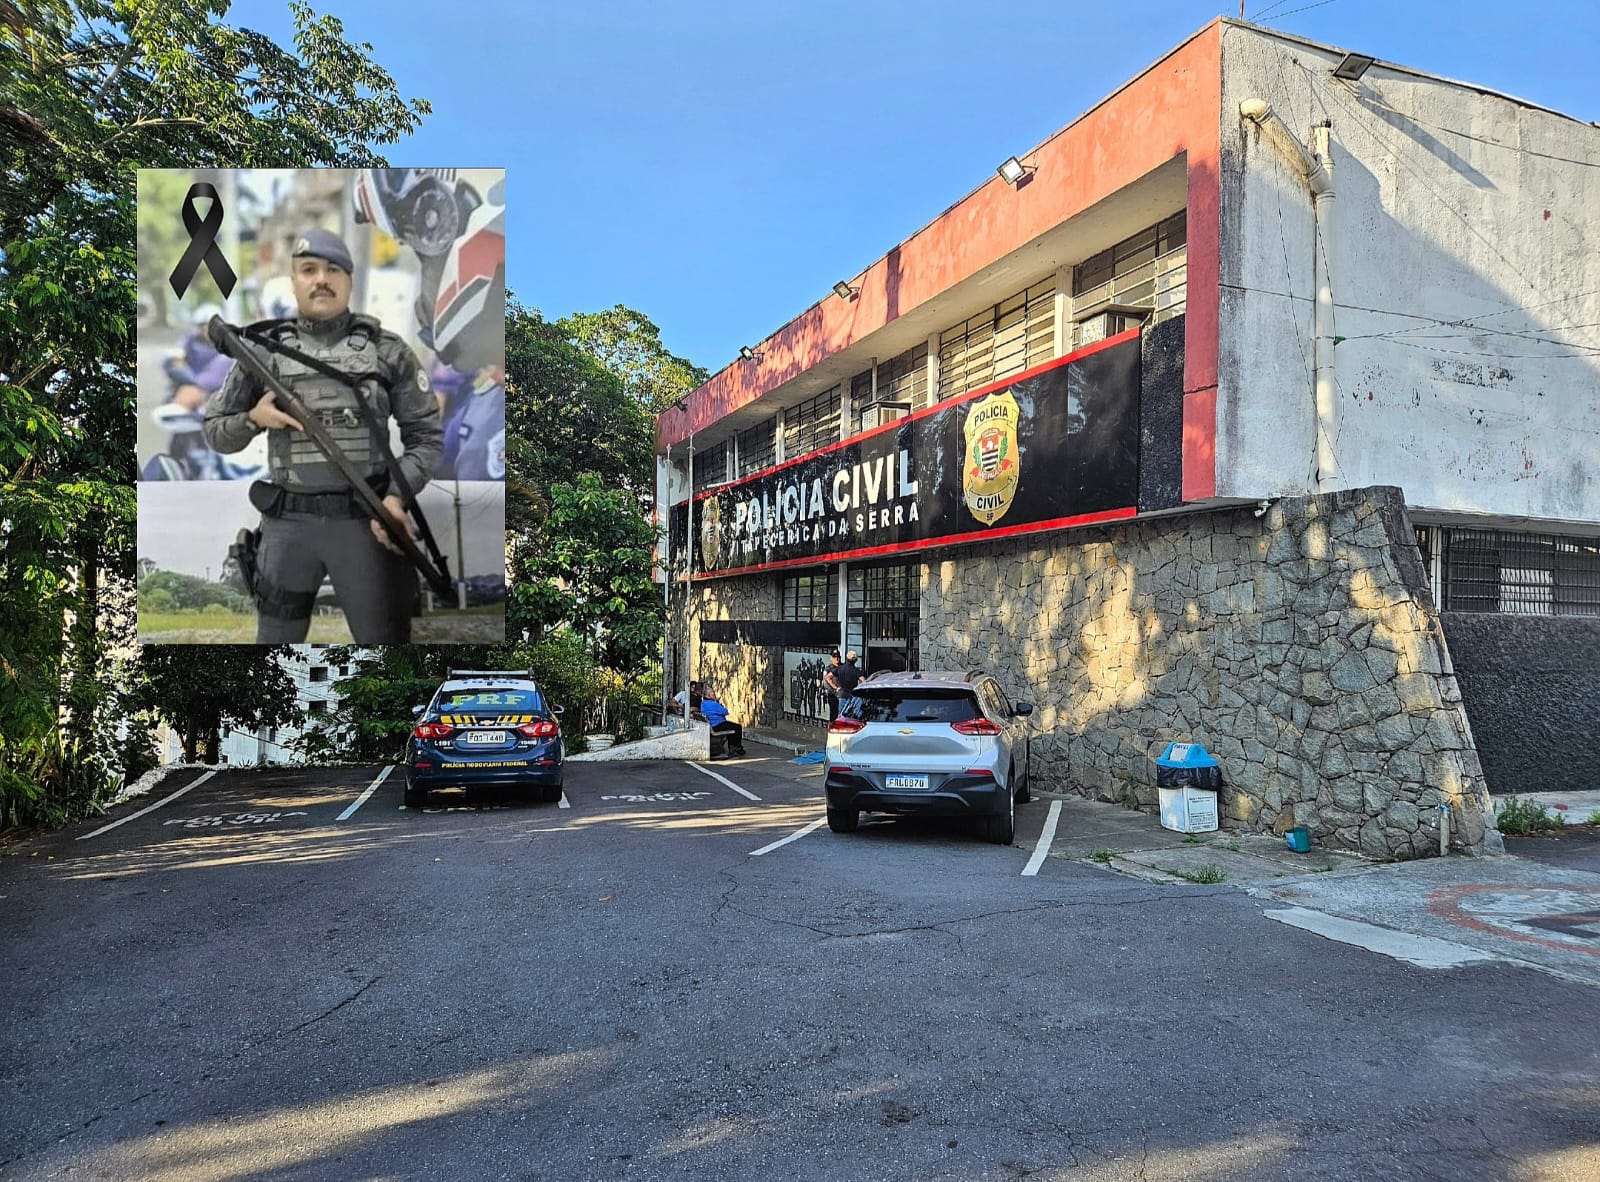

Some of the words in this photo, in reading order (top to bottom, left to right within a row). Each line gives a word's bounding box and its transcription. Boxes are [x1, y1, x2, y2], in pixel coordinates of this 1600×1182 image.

[833, 449, 919, 513] CIVIL
[976, 494, 1004, 510] CIVIL
[829, 517, 849, 537] DA
[855, 501, 919, 532] SERRA
[986, 512, 994, 521] SP
[450, 693, 525, 706] PRF
